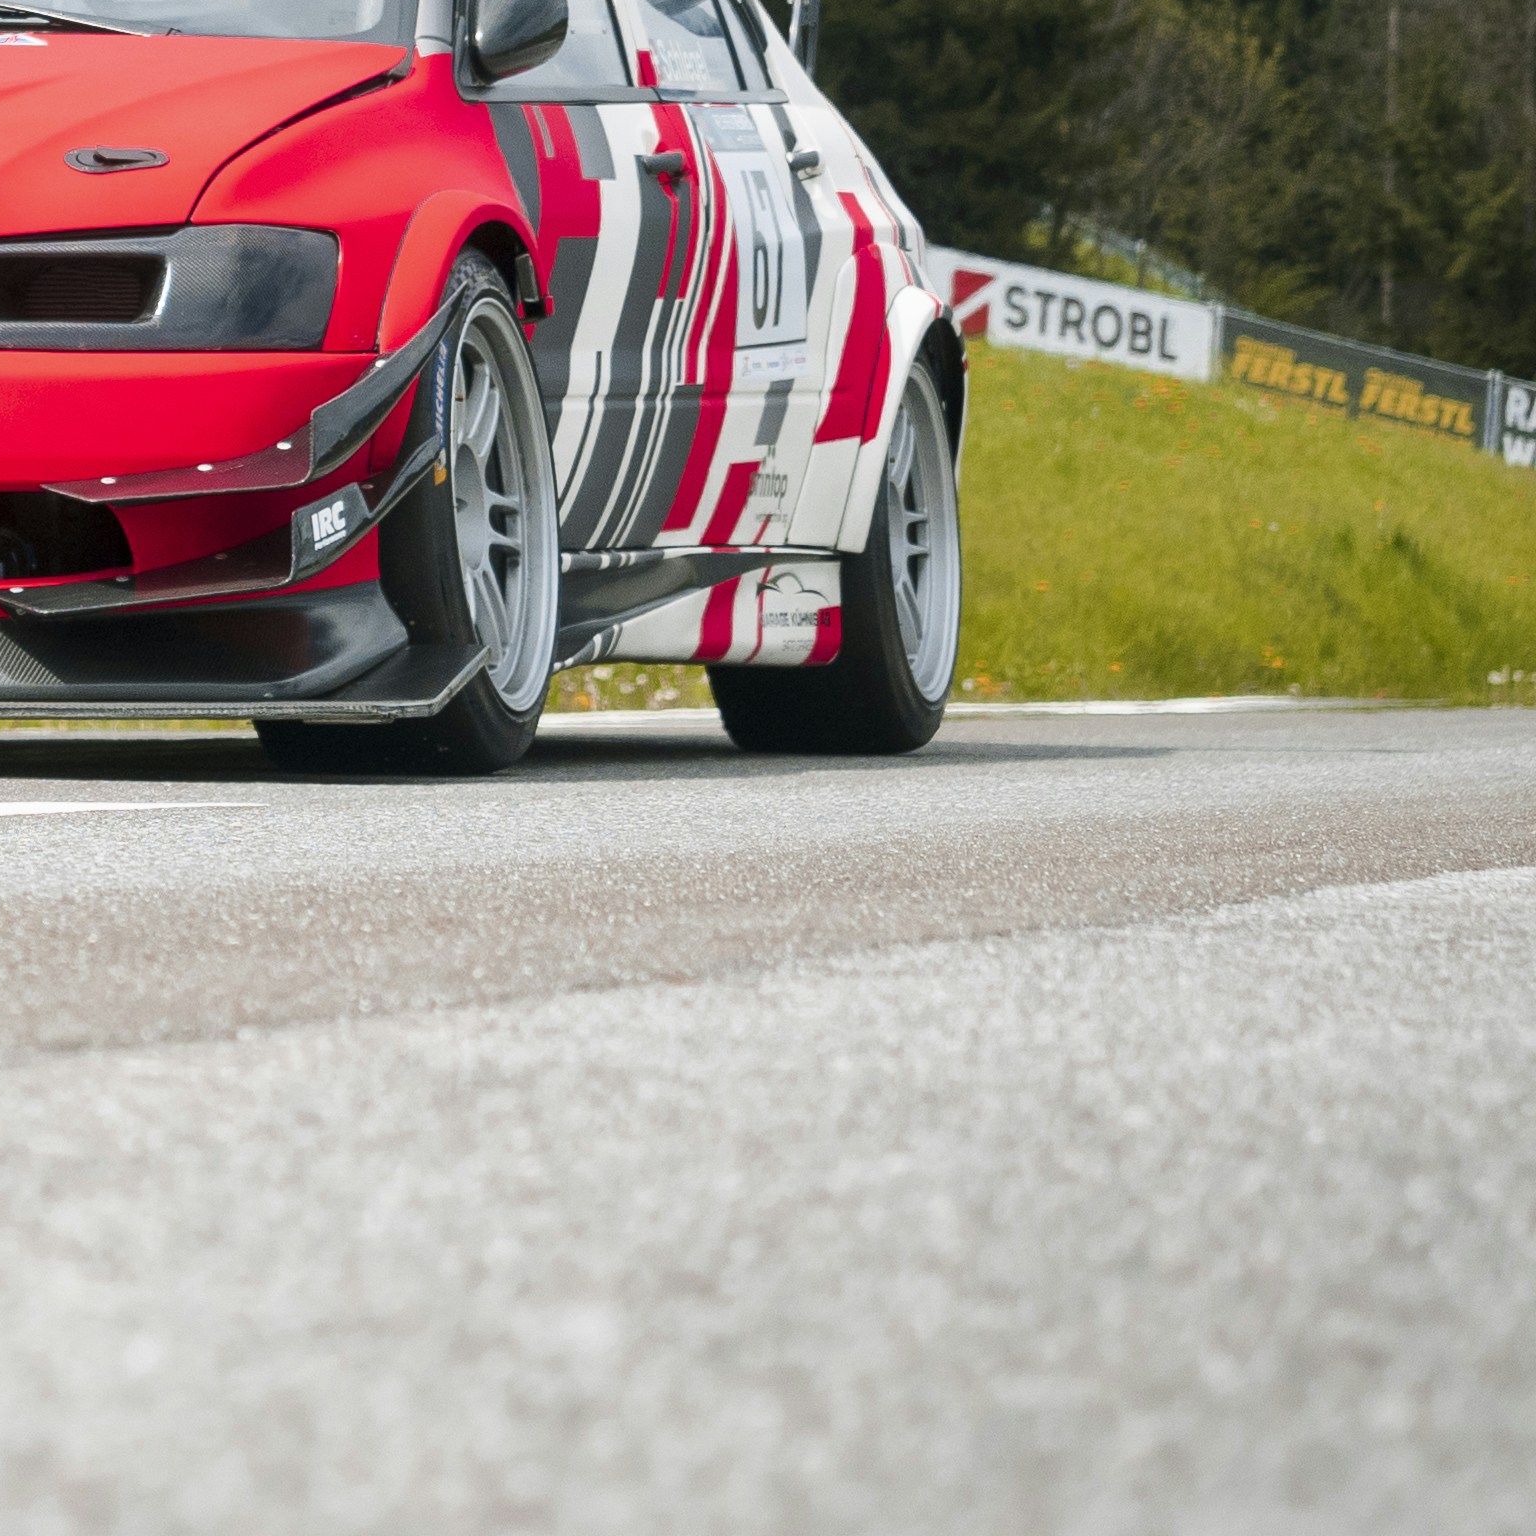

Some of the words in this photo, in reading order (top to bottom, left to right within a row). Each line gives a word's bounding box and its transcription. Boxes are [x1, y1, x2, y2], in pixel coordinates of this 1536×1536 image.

[740, 170, 783, 330] 67
[1004, 284, 1178, 361] STROBL
[1231, 351, 1349, 405] FERSTL
[1359, 383, 1475, 435] FERSTL
[311, 500, 346, 542] IRC
